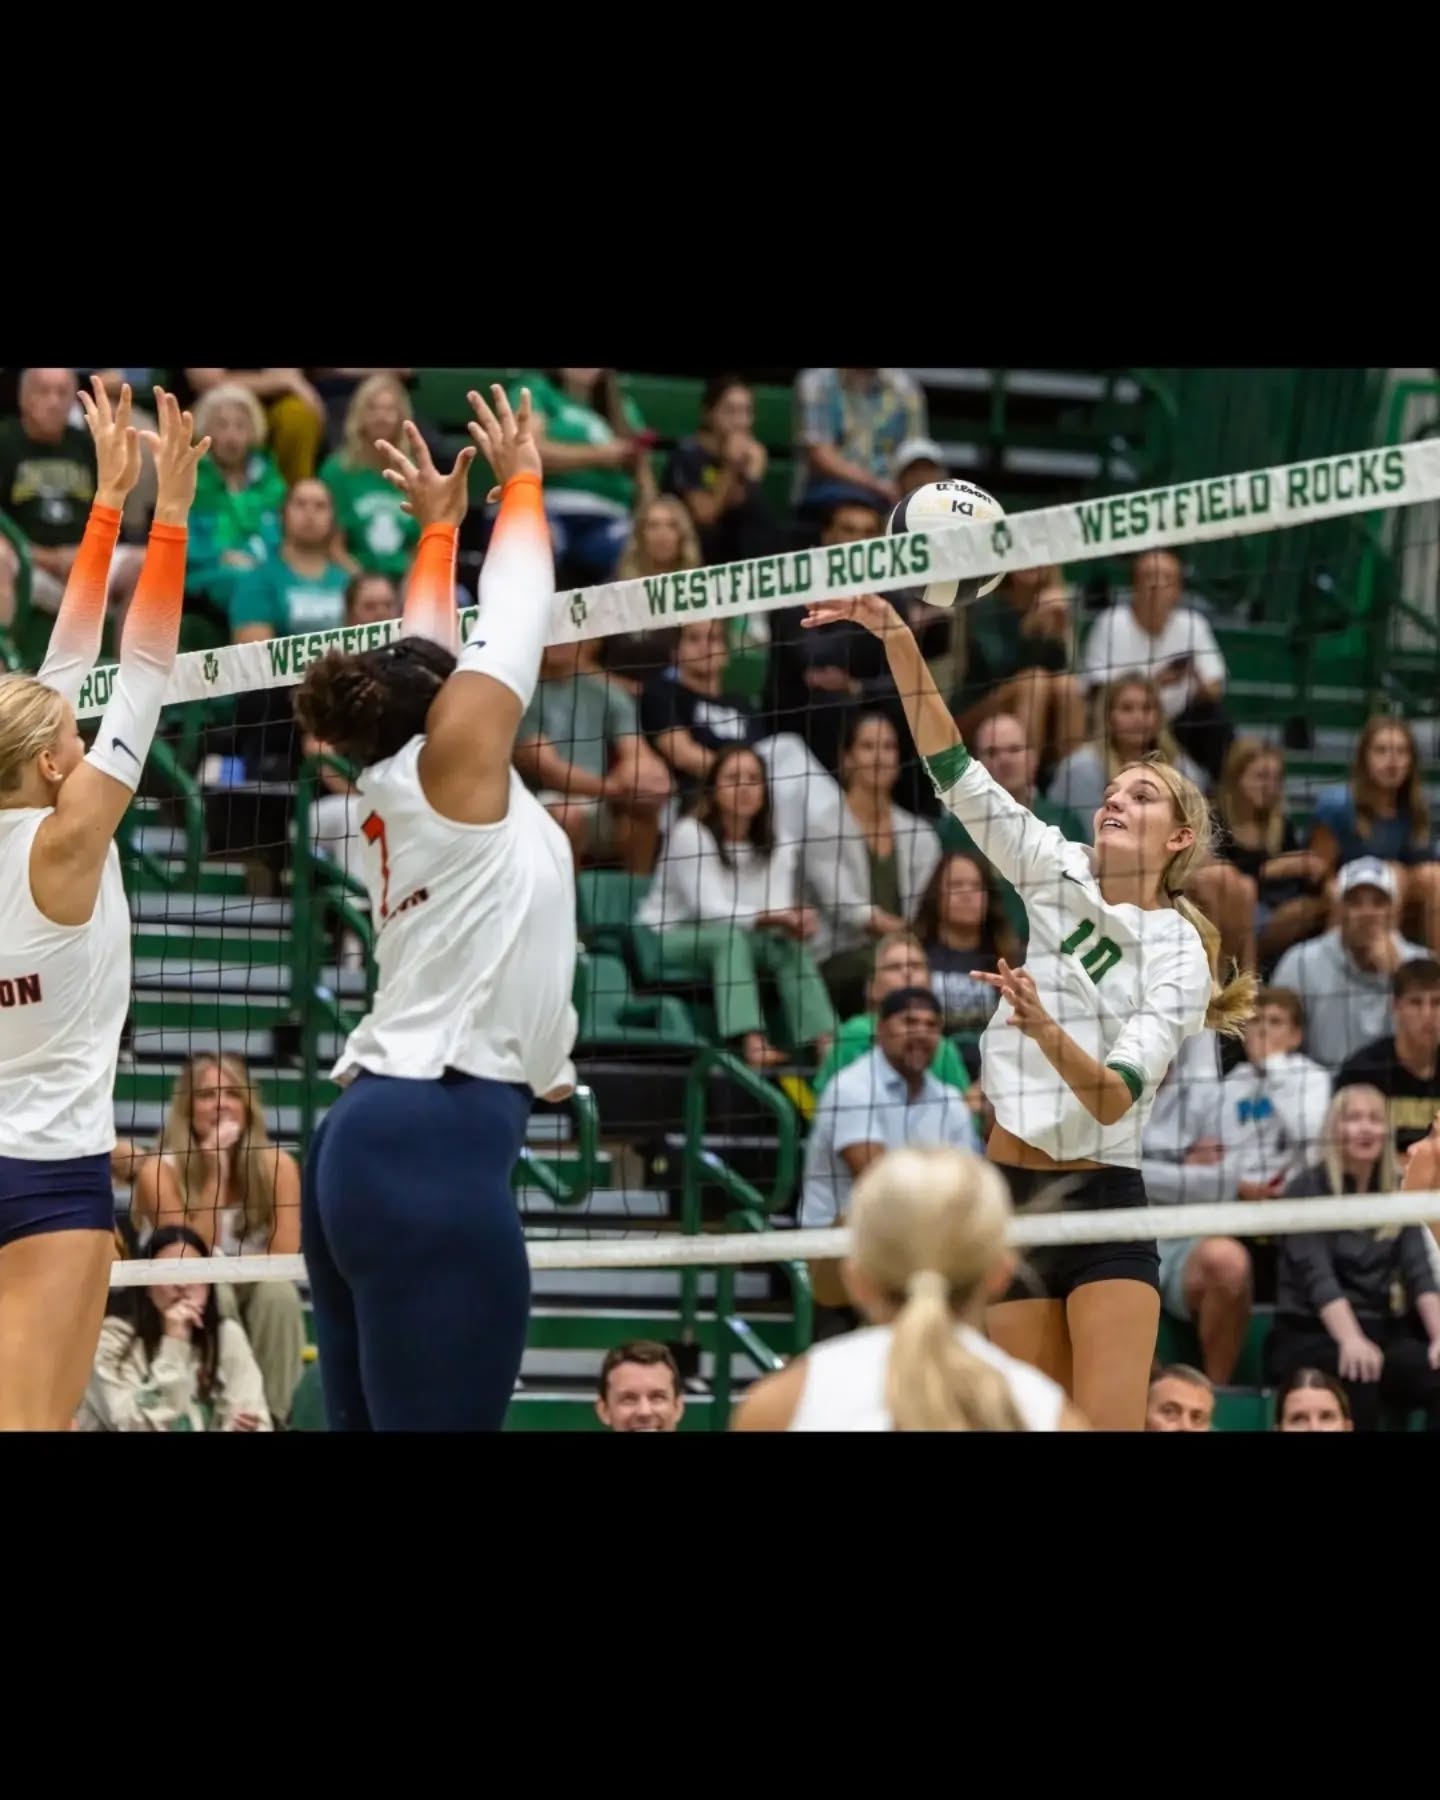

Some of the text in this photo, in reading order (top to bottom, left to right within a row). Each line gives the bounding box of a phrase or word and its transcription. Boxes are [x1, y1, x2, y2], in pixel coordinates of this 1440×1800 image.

[1075, 450, 1406, 545] WESTFIELD ROCKS
[644, 533, 930, 616] WESTFIELD ROCKS
[1059, 917, 1123, 986] 10
